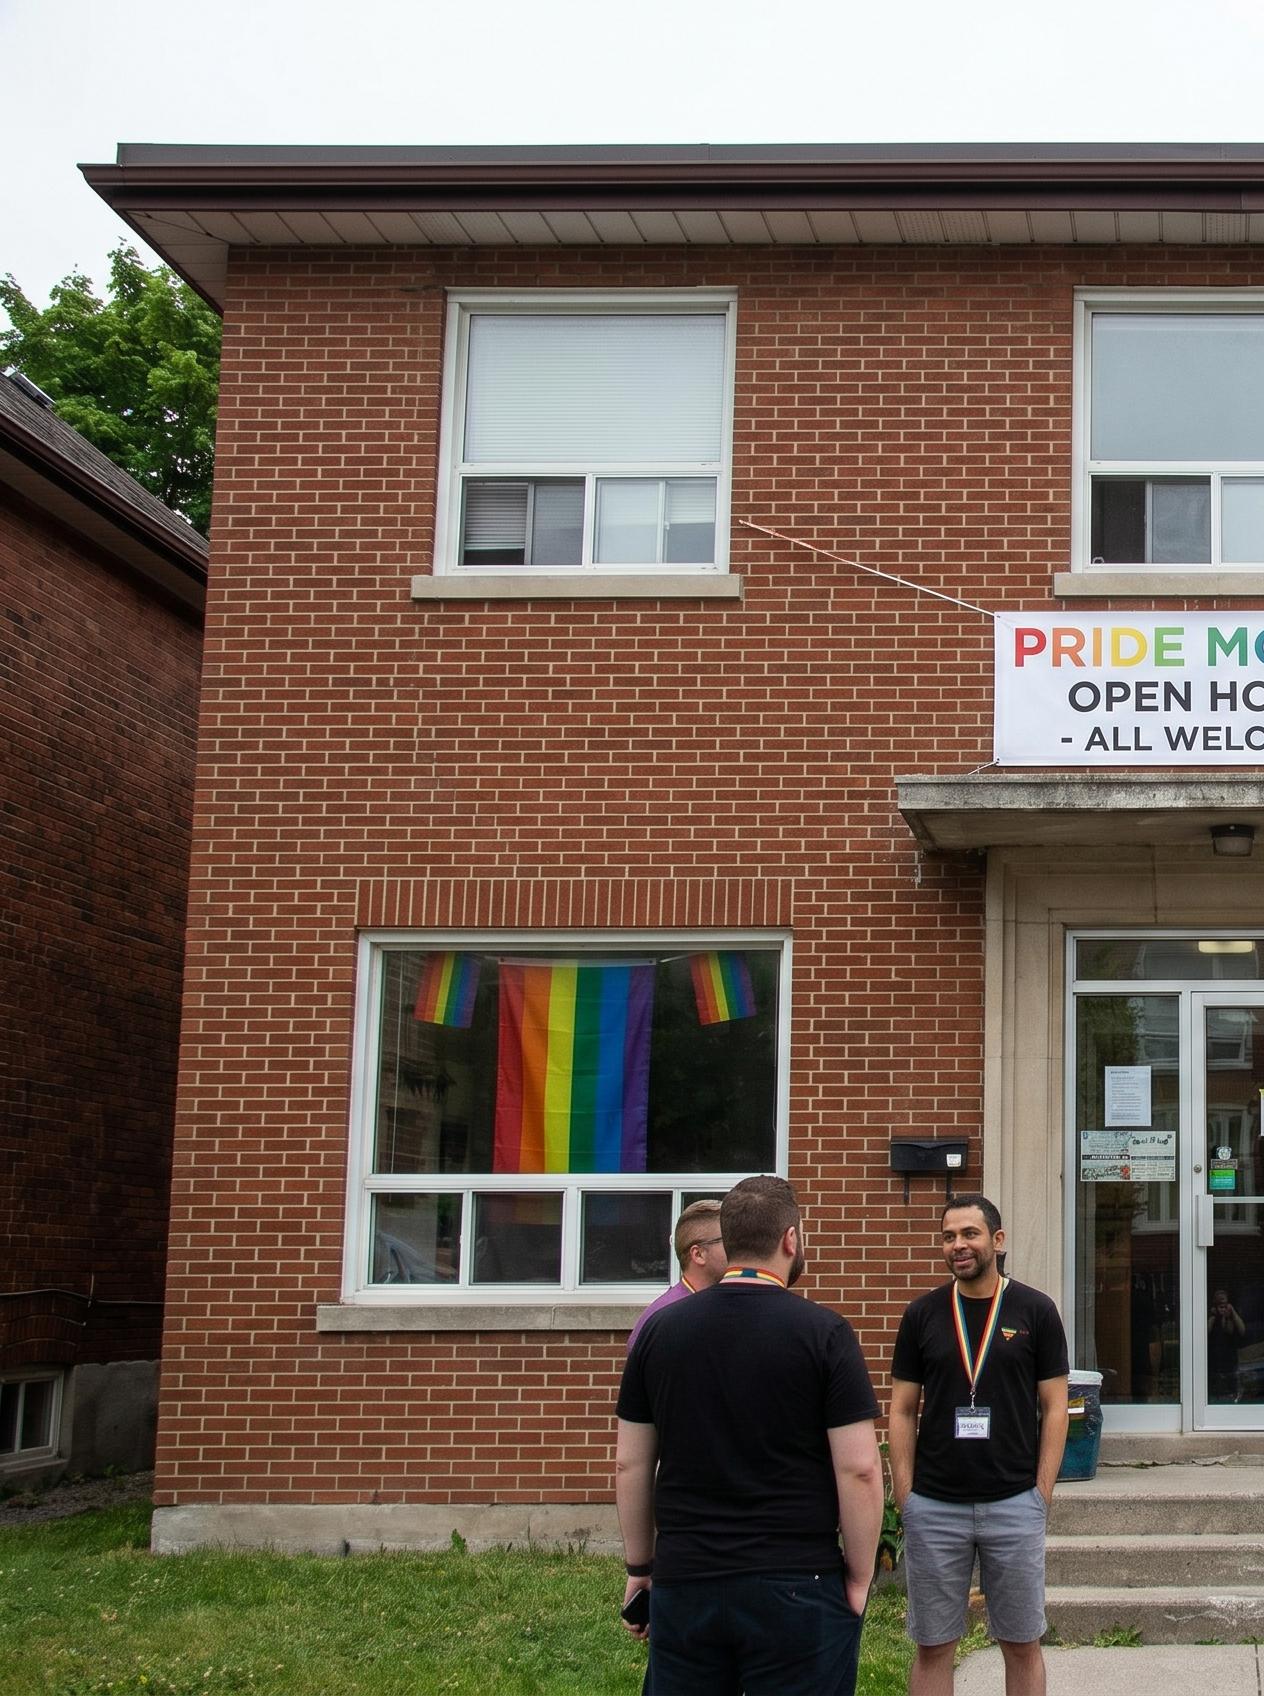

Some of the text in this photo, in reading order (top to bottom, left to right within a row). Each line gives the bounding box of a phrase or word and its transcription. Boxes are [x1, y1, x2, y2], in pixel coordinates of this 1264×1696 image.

[1014, 627, 1185, 668] PRIDE
[1068, 680, 1192, 713] OPEN
[1084, 726, 1153, 752] ALL
